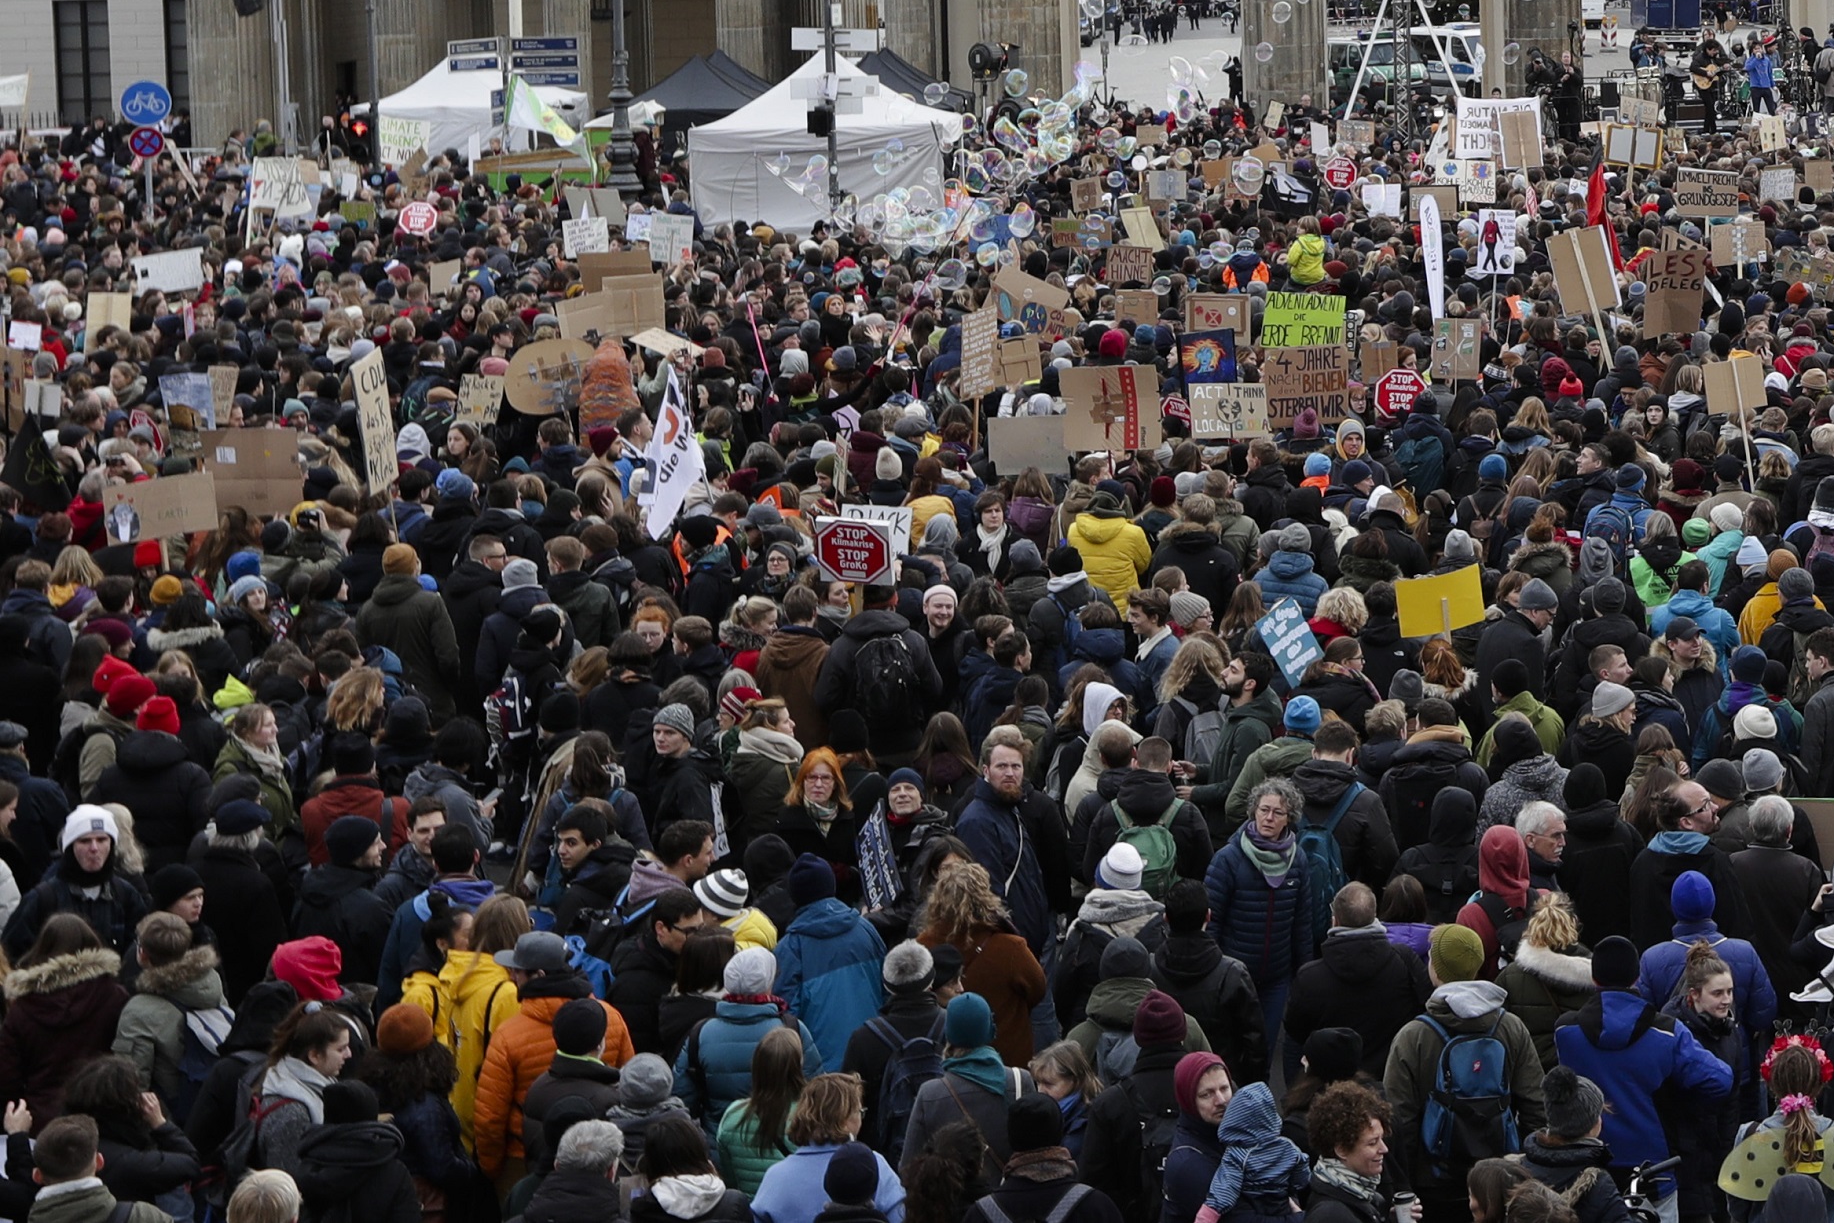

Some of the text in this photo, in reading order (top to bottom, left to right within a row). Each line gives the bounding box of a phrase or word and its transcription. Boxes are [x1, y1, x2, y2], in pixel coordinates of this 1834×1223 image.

[1678, 171, 1739, 186] UMWELTRECHTE
[1679, 193, 1739, 208] GRUNDGESETZ
[1112, 250, 1149, 265] MACHT
[1111, 264, 1148, 280] HINNE
[1293, 312, 1307, 322] DIE
[1261, 324, 1342, 347] ERDE BRENNT
[1276, 347, 1341, 375] 4 JAHRE
[361, 361, 387, 394] CDU
[1268, 370, 1347, 394] NACH BIENEN
[1390, 374, 1414, 385] STOP
[1193, 385, 1265, 399] ACT THINK
[1277, 386, 1296, 396] den
[1386, 381, 1418, 392] Klimakrise
[1389, 392, 1413, 403] STOP
[1268, 394, 1347, 420] STERBEN WIR
[1194, 418, 1230, 434] LOCAL
[836, 526, 869, 541] STOP
[830, 536, 875, 551] Klimakrise
[837, 547, 870, 562] STOP
[839, 559, 869, 572] GroKo
